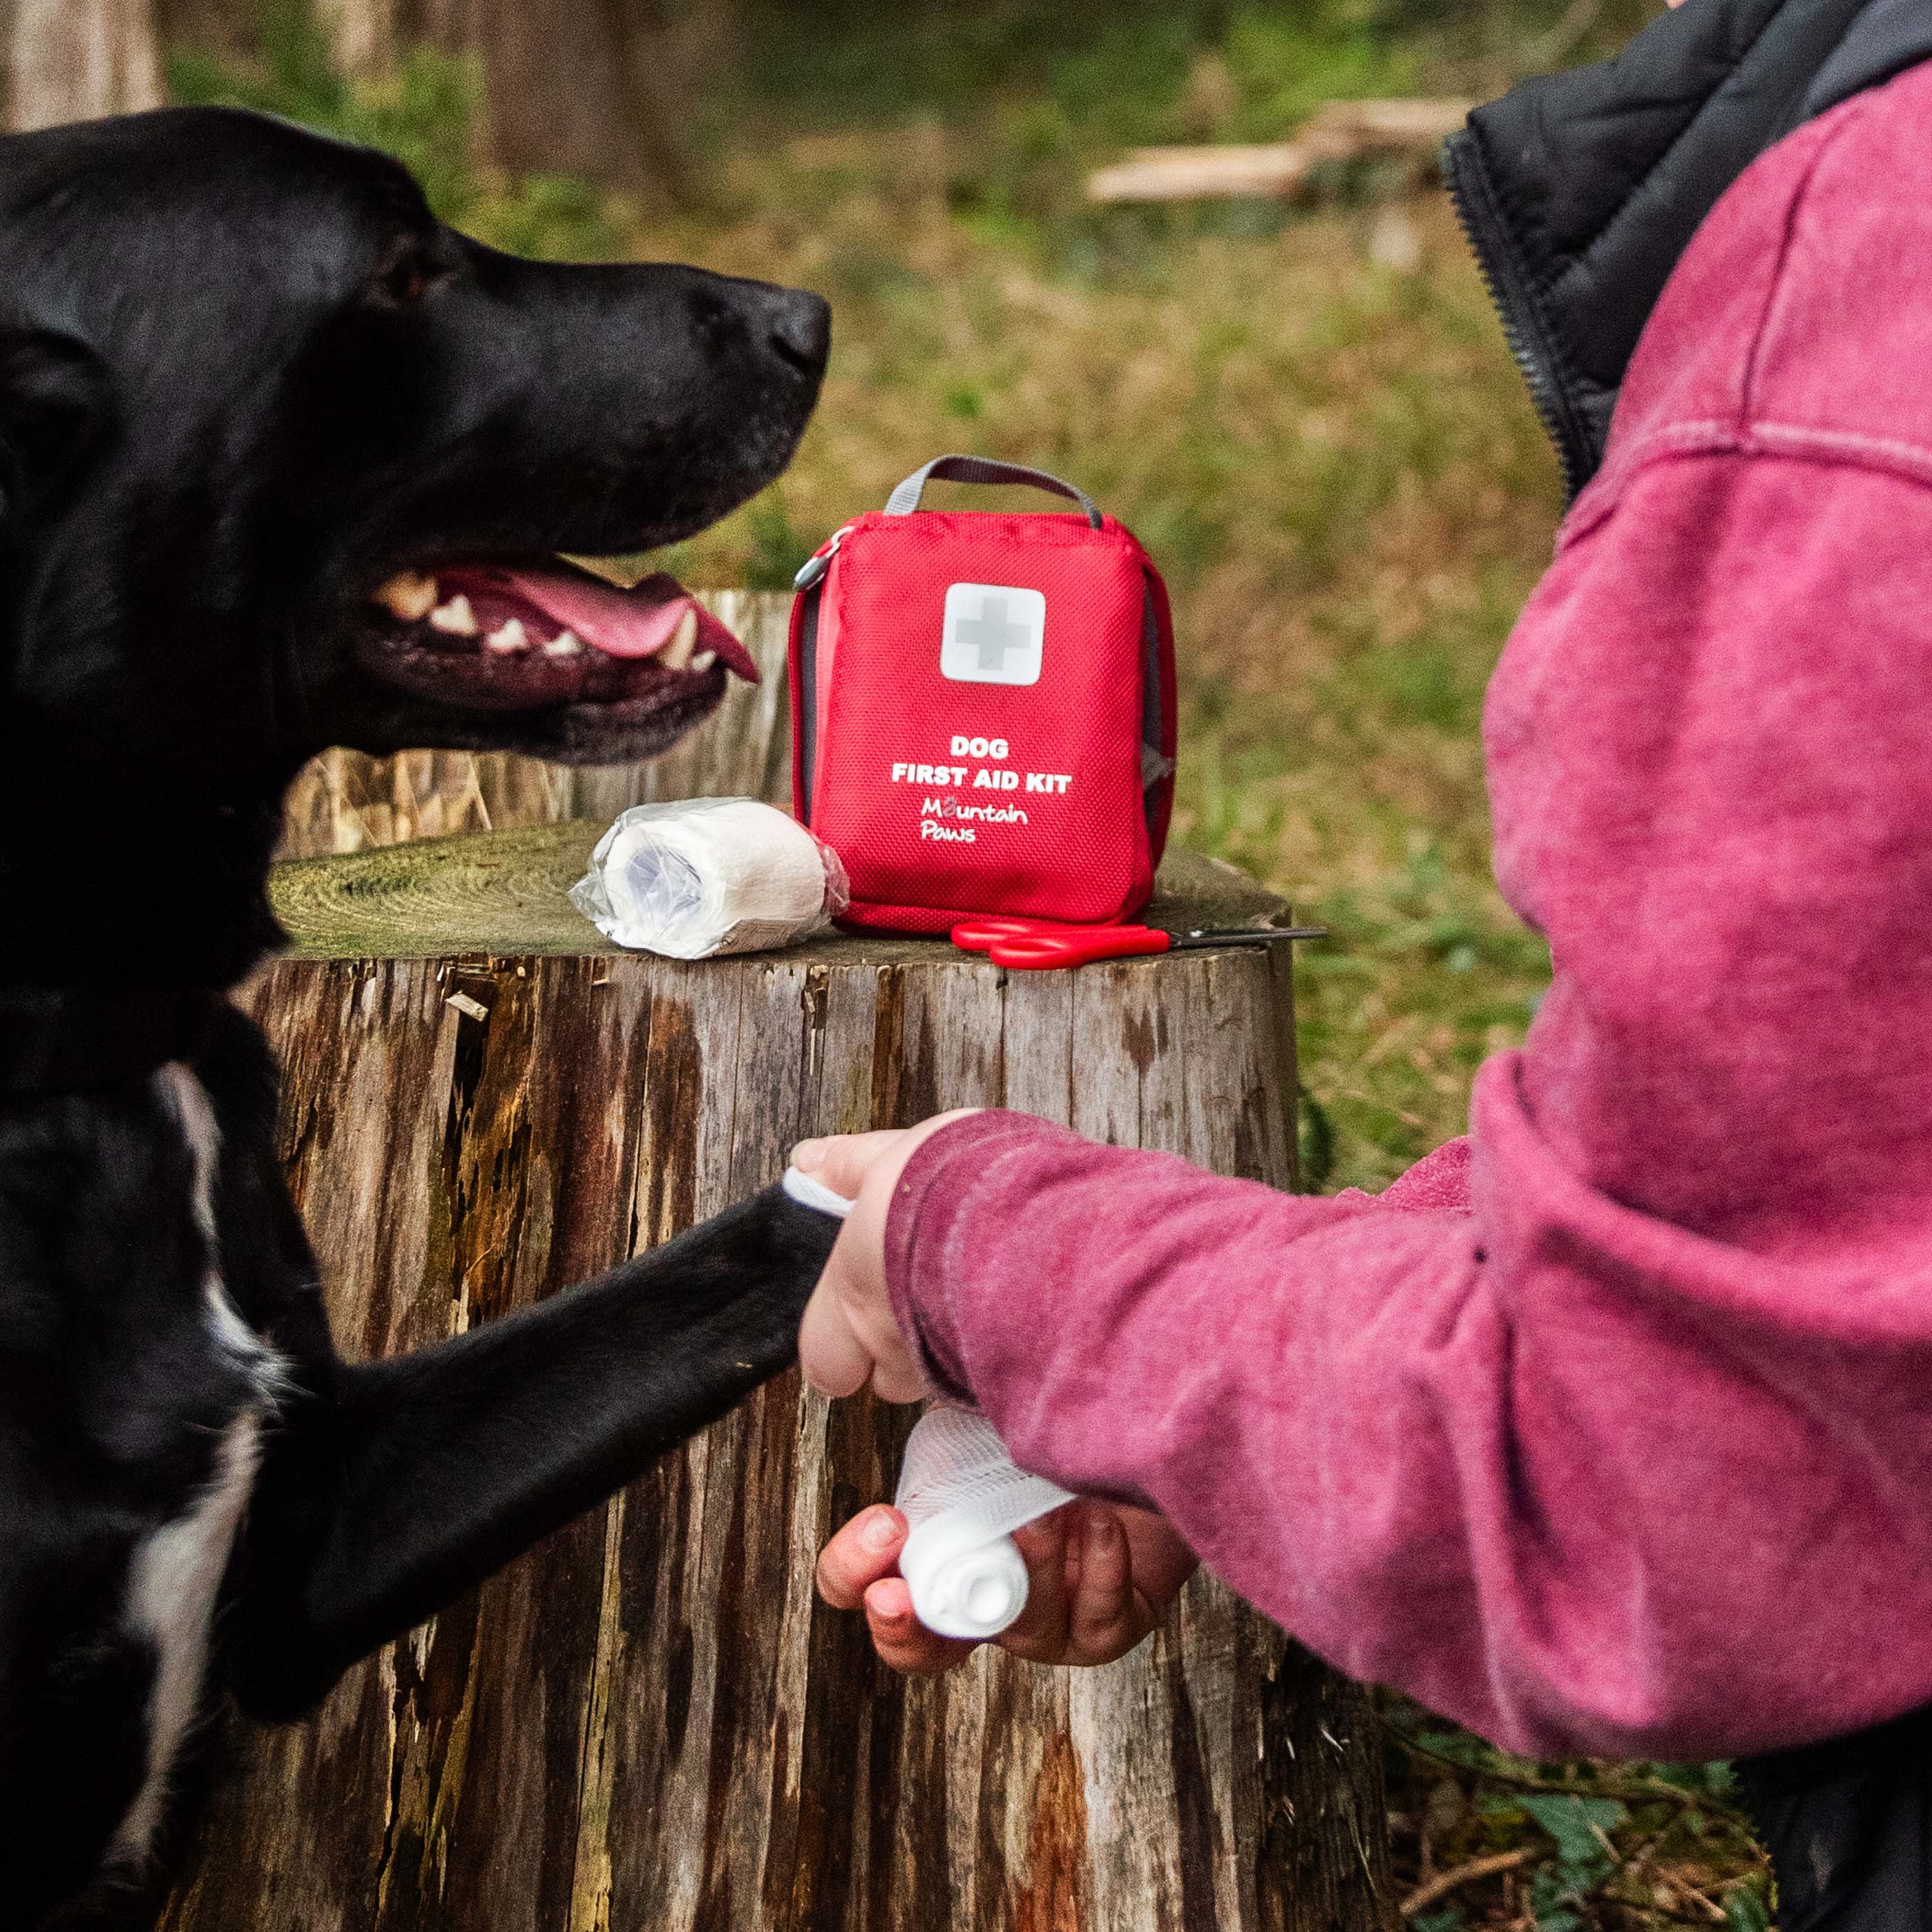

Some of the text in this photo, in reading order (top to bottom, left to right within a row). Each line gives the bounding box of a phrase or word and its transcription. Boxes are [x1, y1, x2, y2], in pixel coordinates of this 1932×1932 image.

[950, 736, 1009, 760] DOG
[891, 762, 1072, 793] FIRST AID KIT
[920, 796, 1028, 825] Mountain
[920, 819, 976, 843] Paws
